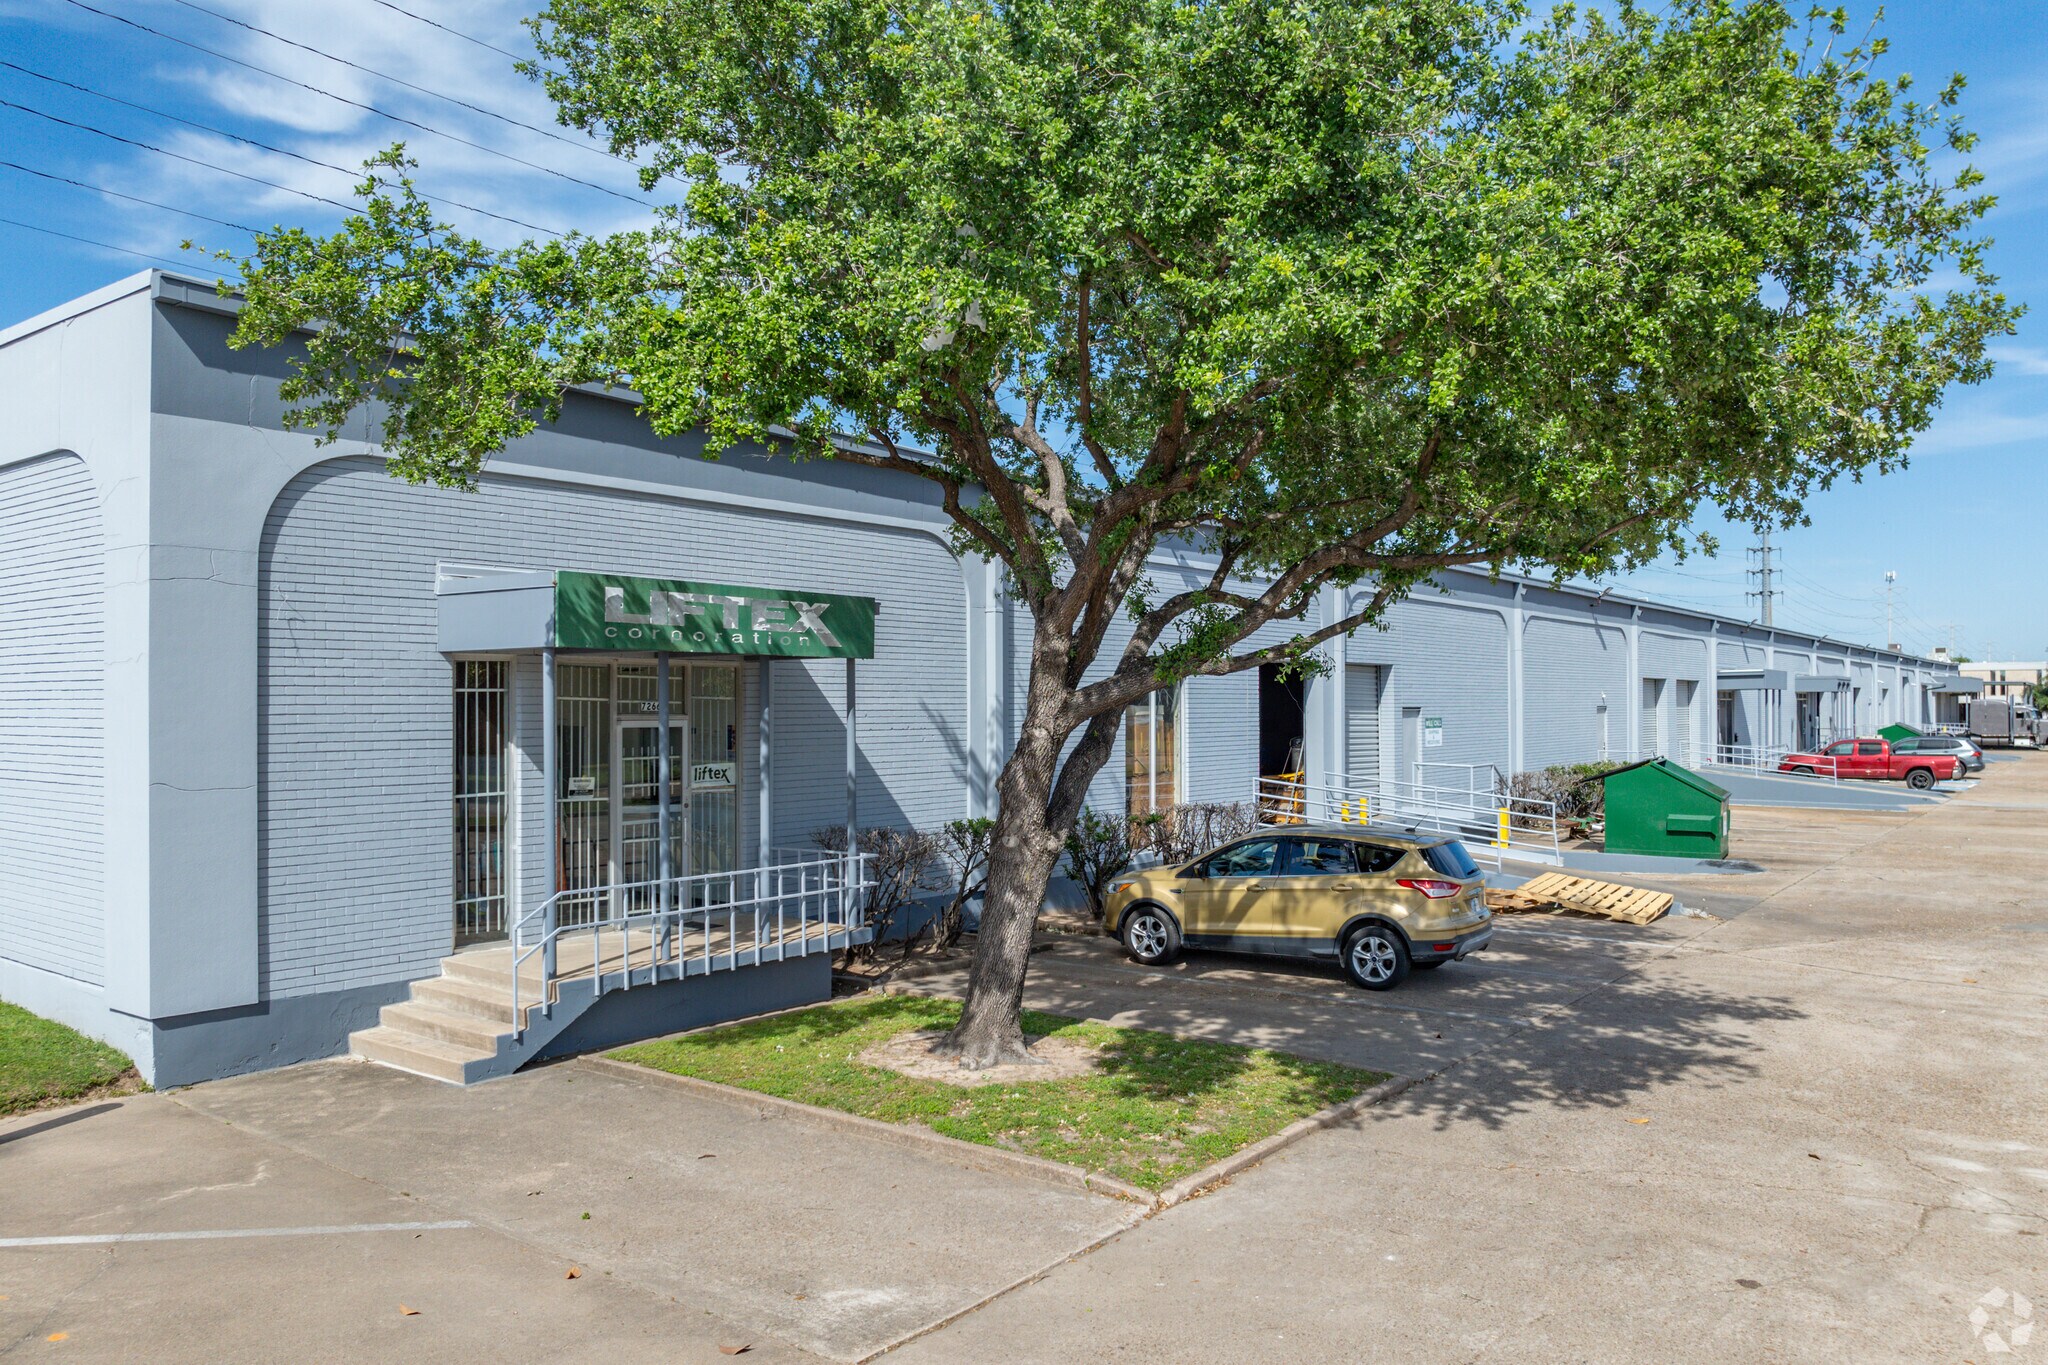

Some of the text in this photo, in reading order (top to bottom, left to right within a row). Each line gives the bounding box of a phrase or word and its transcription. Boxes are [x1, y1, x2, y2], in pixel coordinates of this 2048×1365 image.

[604, 586, 843, 648] LIFTEX
[604, 626, 811, 647] corporation
[694, 766, 731, 783] liftex
